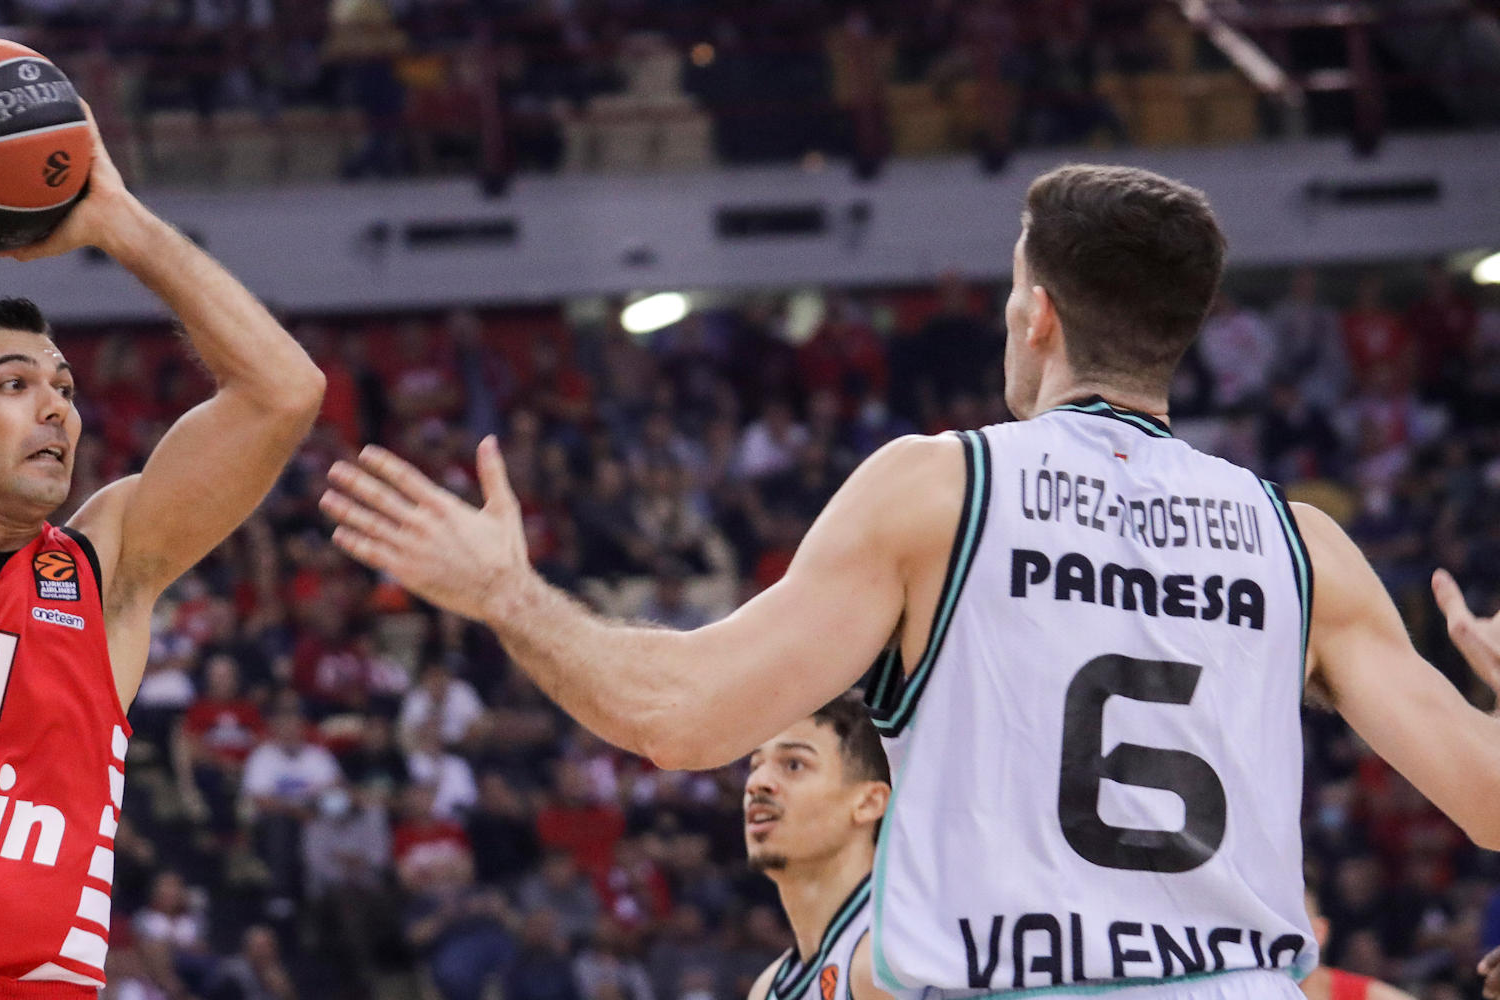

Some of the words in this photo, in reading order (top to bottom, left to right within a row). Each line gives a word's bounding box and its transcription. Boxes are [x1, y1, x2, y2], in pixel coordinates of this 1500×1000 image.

[39, 580, 77, 588] TURKISH
[40, 586, 78, 594] AIRLINES
[1010, 548, 1265, 631] PAMESA
[1058, 653, 1227, 873] 6
